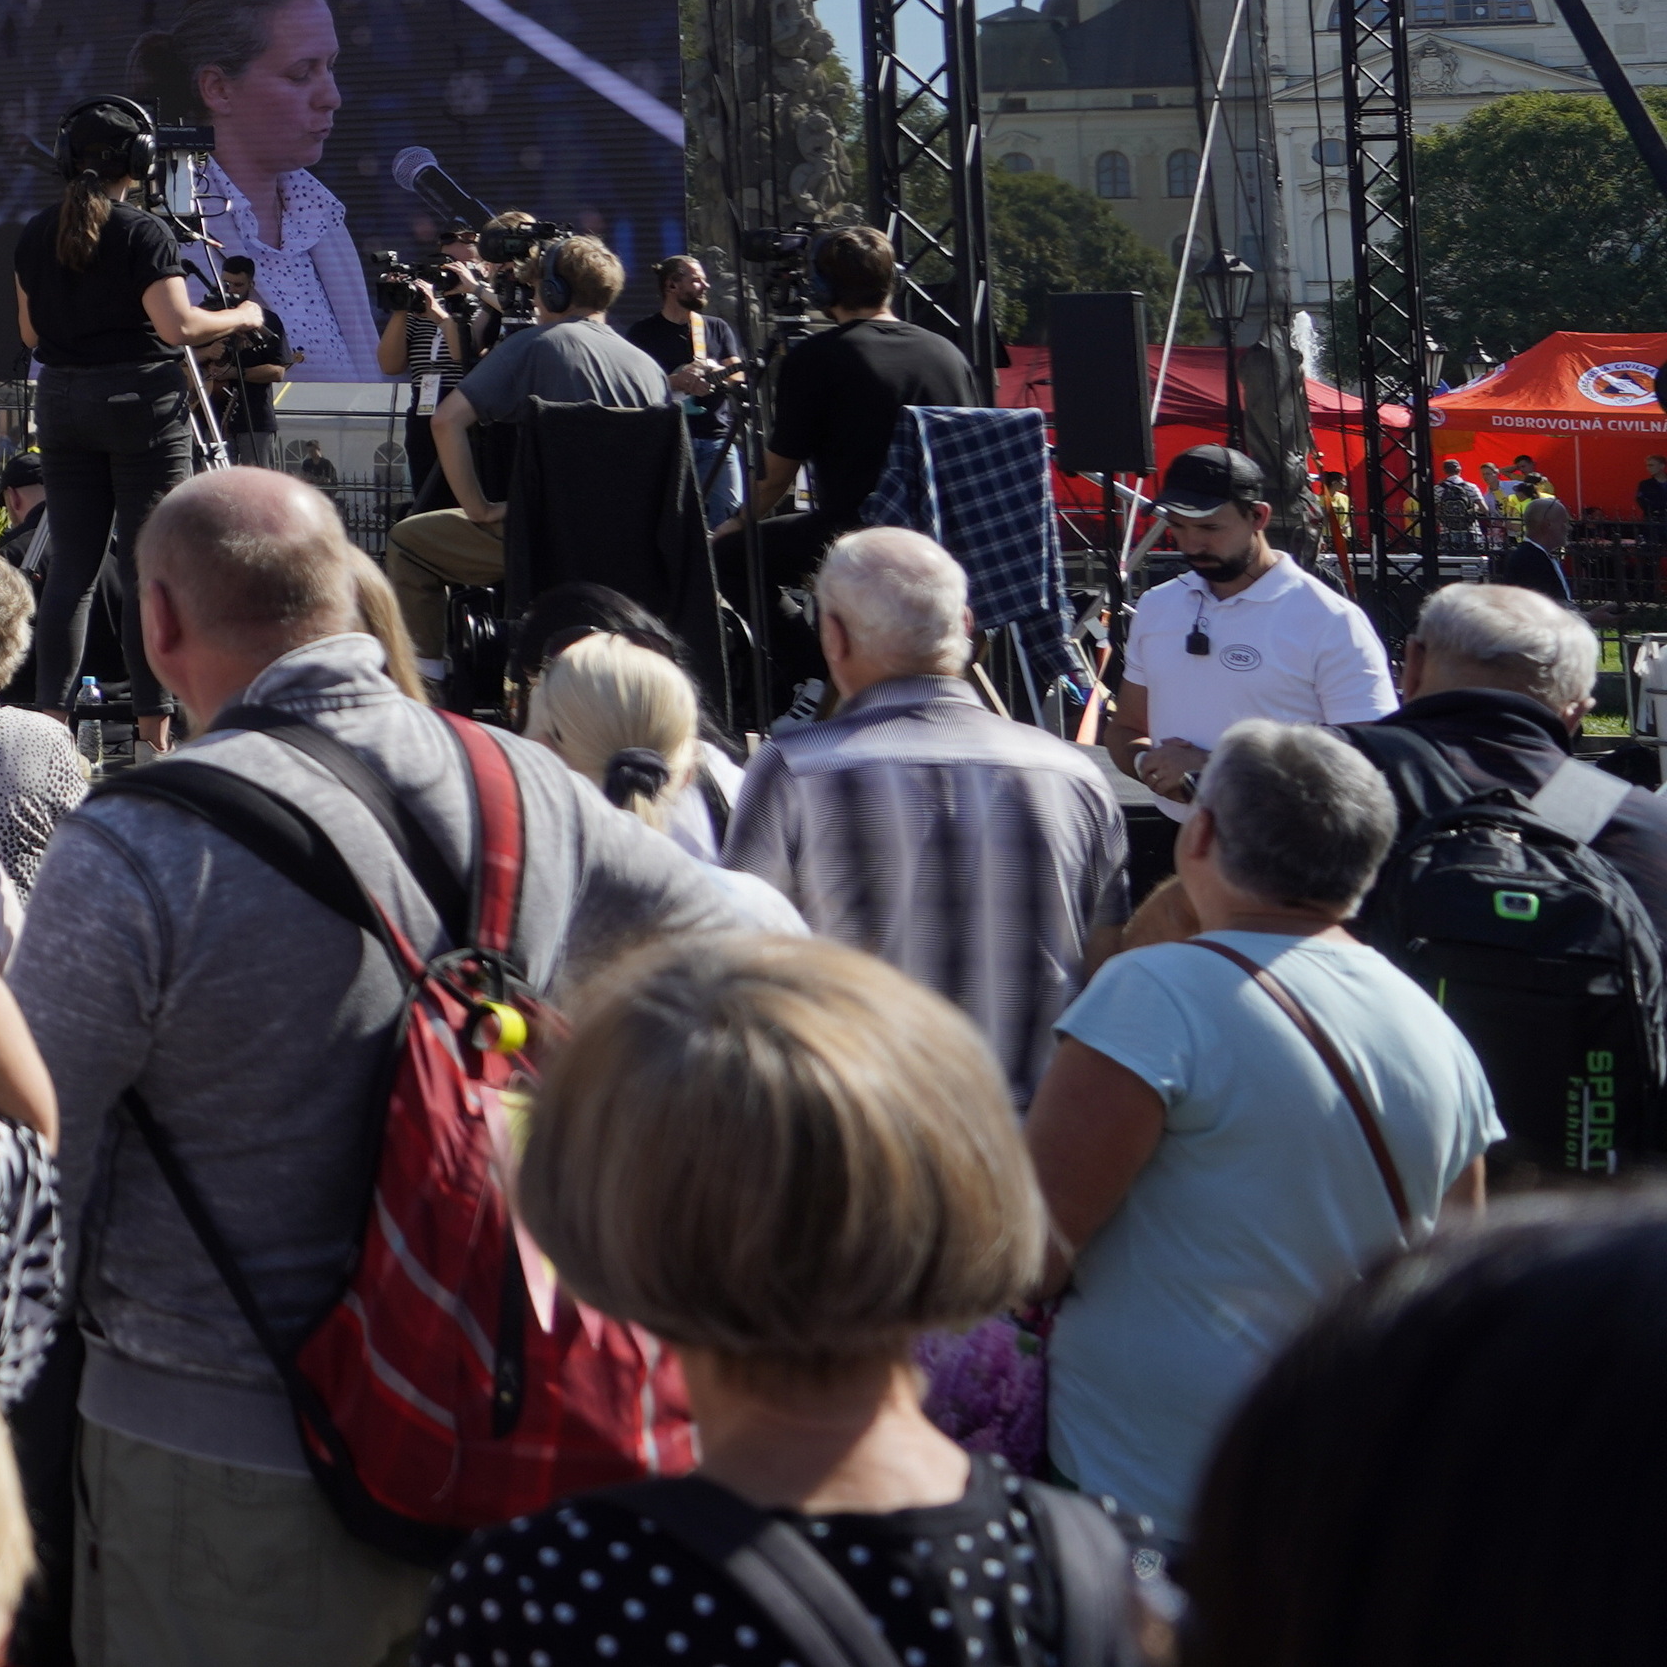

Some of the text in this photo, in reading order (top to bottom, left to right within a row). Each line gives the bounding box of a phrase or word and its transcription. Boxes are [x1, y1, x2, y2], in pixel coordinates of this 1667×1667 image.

[1492, 415, 1604, 432] DOBROVOĽNÁ
[1565, 1076, 1585, 1168] Fashion
[1586, 1050, 1616, 1175] SPORT
